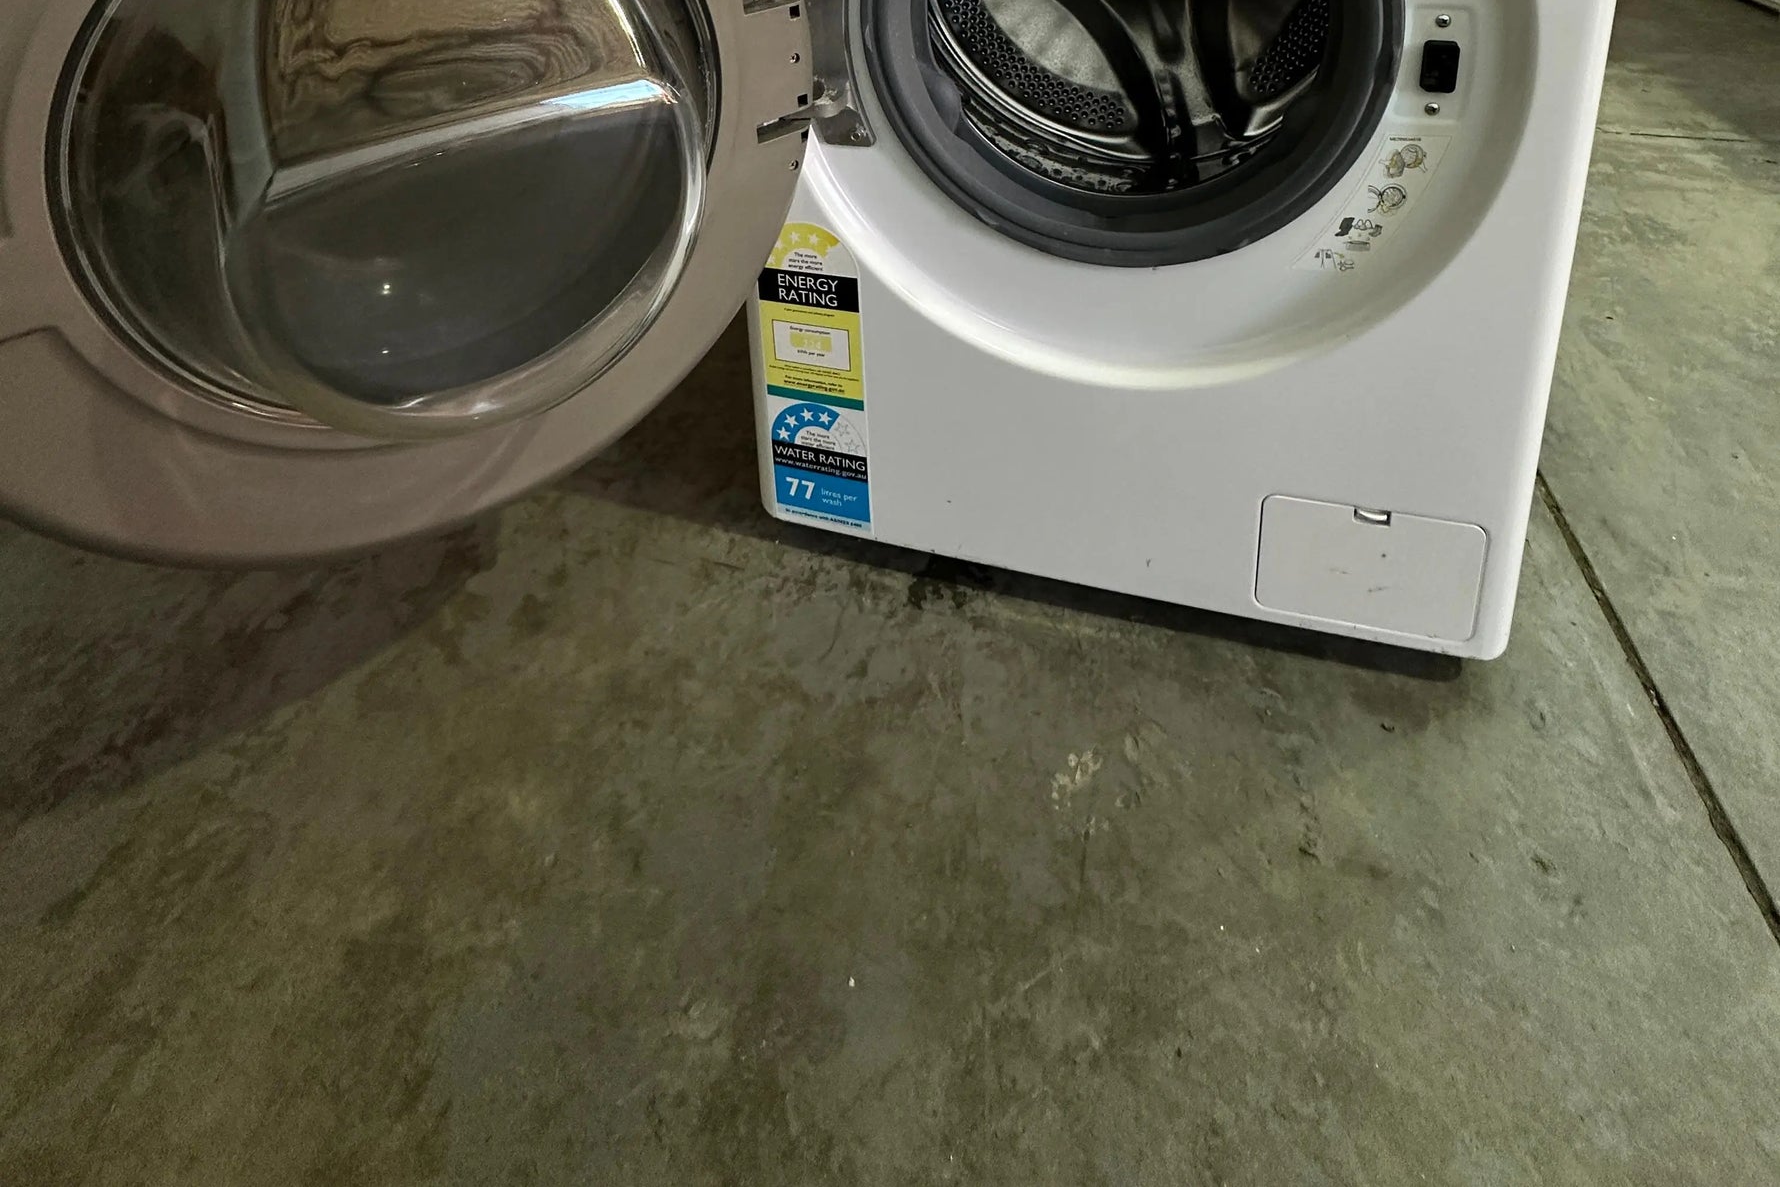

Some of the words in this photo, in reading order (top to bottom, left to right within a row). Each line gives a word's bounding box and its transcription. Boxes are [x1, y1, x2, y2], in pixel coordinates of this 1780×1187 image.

[777, 273, 838, 292] ENERGY
[779, 288, 838, 307] RATING
[774, 444, 816, 462] WATER
[819, 454, 866, 471] RATING
[775, 456, 867, 480] www.waterrating.gov.au
[785, 476, 815, 500] 77
[821, 487, 841, 499] litres
[843, 494, 857, 502] per
[822, 498, 842, 507] wash
